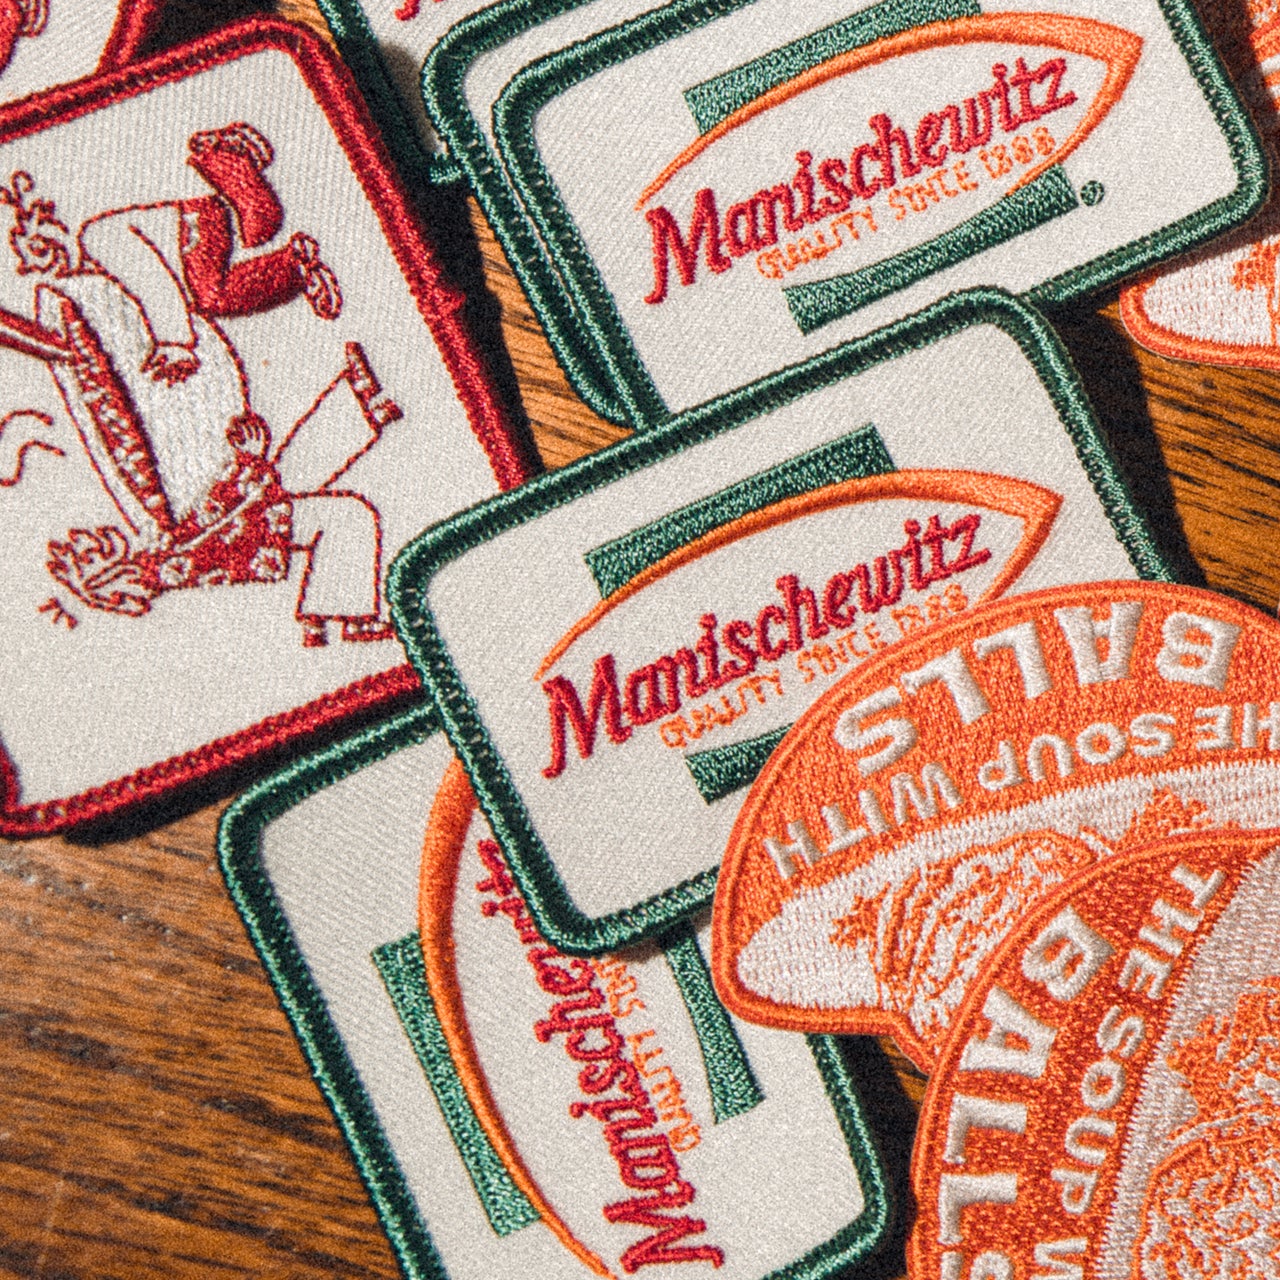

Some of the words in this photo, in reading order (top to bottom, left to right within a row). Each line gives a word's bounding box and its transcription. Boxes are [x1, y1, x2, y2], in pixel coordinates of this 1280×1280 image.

[644, 57, 1079, 306] Manischewitz
[756, 204, 880, 281] QUALITY
[888, 160, 980, 221] SINCE
[541, 514, 993, 780] Manischewitz
[659, 668, 785, 750] QUALITY
[795, 622, 887, 684] SINCE
[833, 600, 1242, 780] BALLS
[763, 761, 962, 880] WITH
[975, 713, 1177, 793] SOUP
[1119, 860, 1226, 1001] THE
[1050, 1005, 1147, 1215] SOUP
